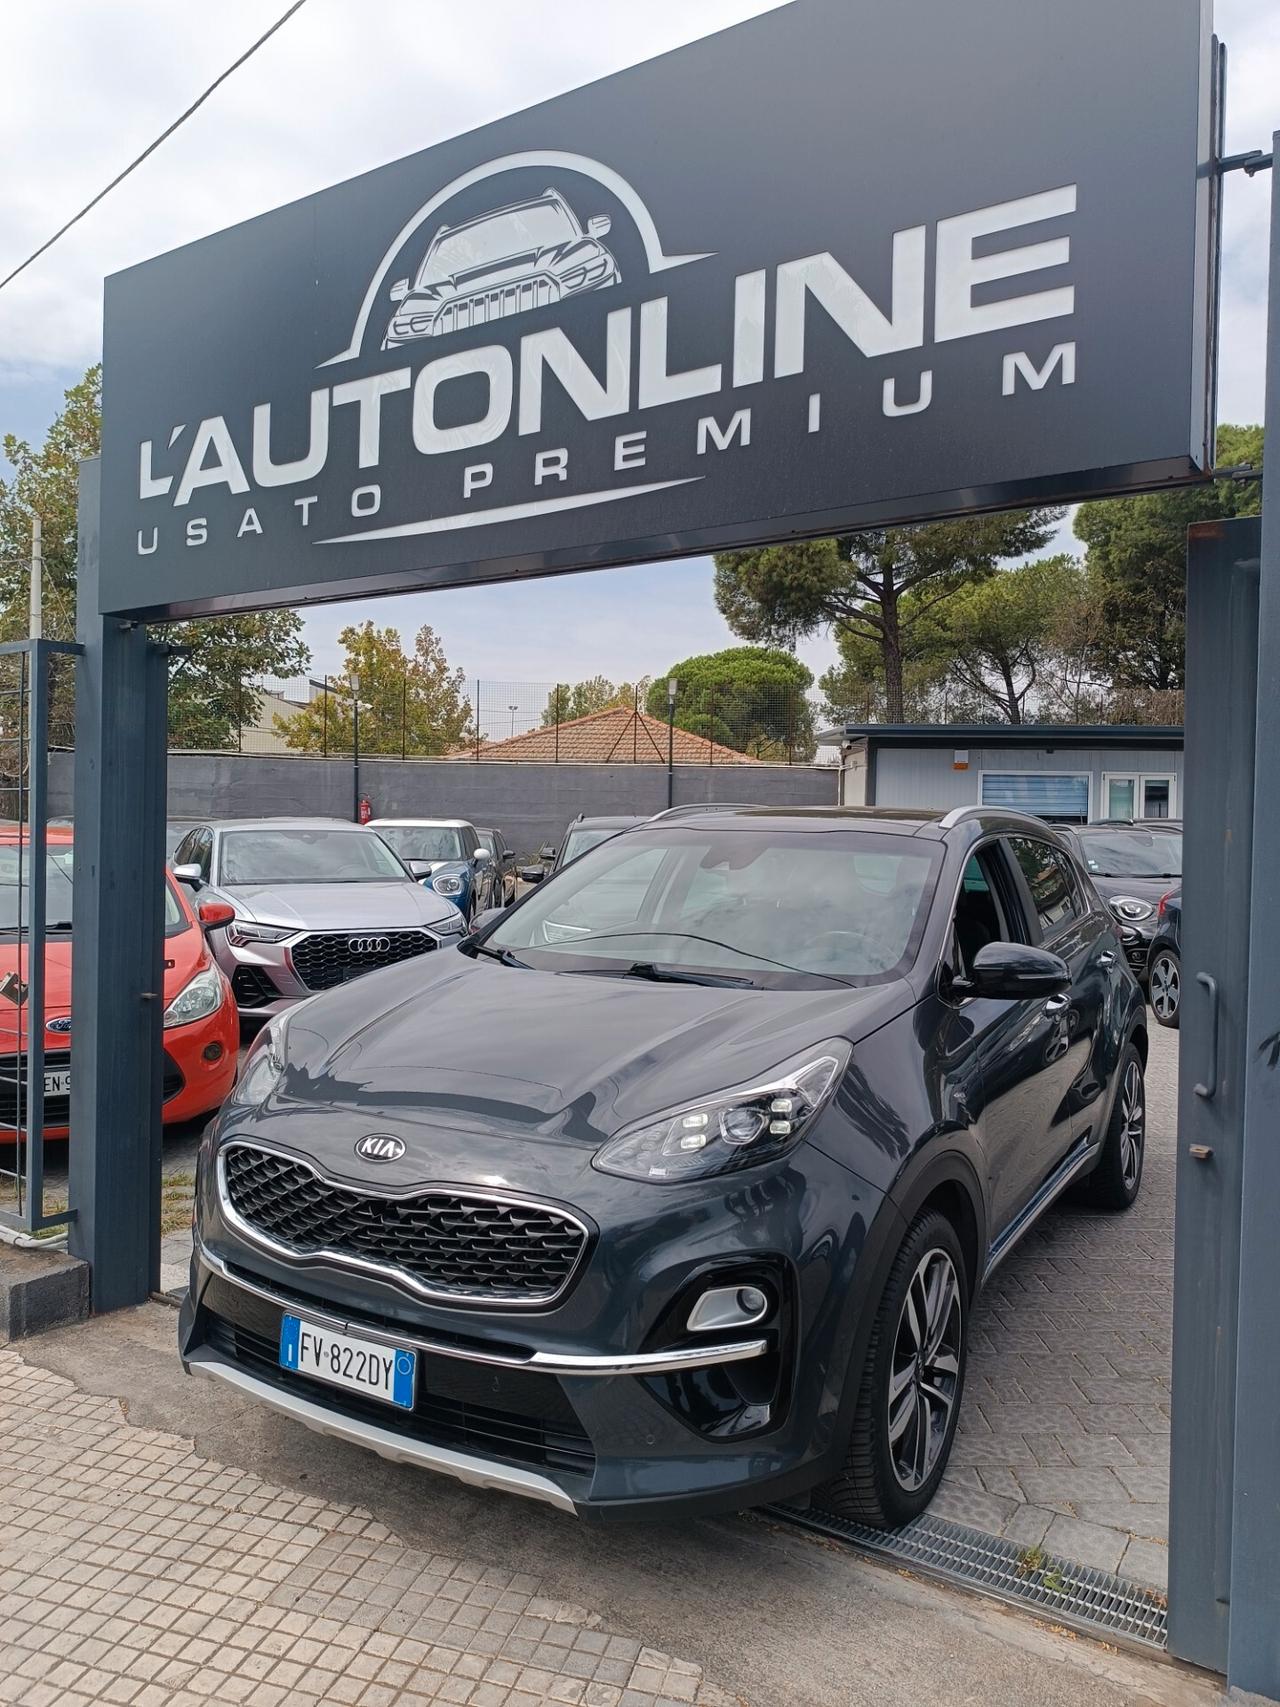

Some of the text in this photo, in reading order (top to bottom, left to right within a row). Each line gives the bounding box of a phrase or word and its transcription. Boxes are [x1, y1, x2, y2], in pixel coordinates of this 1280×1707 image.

[136, 340, 1078, 557] USATO PREMIUM
[360, 1136, 396, 1158] KIA
